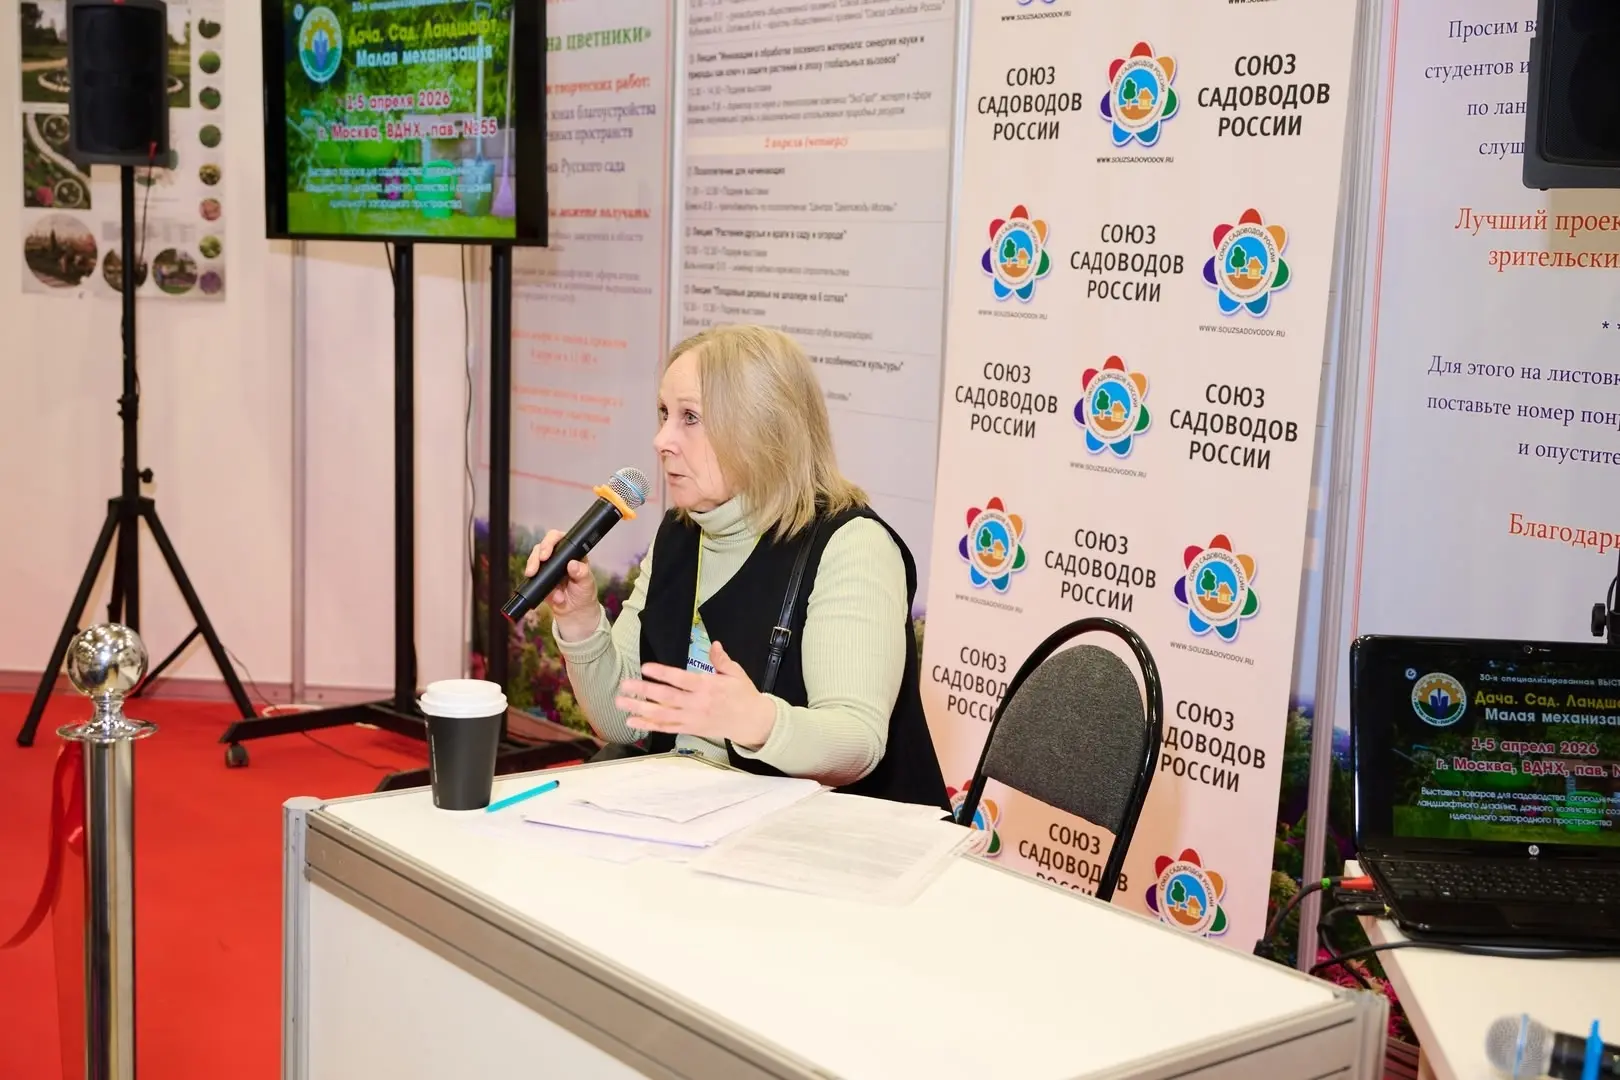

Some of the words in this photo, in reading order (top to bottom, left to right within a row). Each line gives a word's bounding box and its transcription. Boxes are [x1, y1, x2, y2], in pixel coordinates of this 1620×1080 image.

[1449, 20, 1518, 43] Просим
[356, 49, 398, 67] Малая
[402, 45, 492, 64] механизация
[1235, 54, 1296, 76] СОЮЗ
[1007, 66, 1055, 86] СОЮЗ
[1425, 62, 1513, 83] студентов
[370, 96, 414, 112] апреля
[418, 91, 450, 108] 2026
[978, 93, 1082, 117] САДОВОДОВ
[1198, 83, 1330, 111] САДОВОДОВ
[1467, 103, 1488, 116] по
[993, 121, 1060, 140] РОССИИ
[1218, 115, 1302, 137] РОССИИ
[1455, 208, 1548, 236] Лучший
[1101, 224, 1156, 244] СОЮЗ
[1070, 251, 1184, 276] САДОВОДОВ
[1489, 249, 1620, 272] зрительски
[1088, 280, 1161, 302] РОССИИ
[1199, 325, 1285, 337] WWW.SOUZSADOVODOV.RU
[983, 362, 1031, 384] СОЮЗ
[1427, 355, 1462, 376] Для
[1467, 363, 1514, 378] этого
[1521, 366, 1540, 380] на
[955, 385, 1058, 414] САДОВОДОВ
[1205, 383, 1265, 408] СОЮЗ
[1427, 397, 1511, 416] поставьте
[1517, 404, 1574, 427] номер
[970, 414, 1036, 438] РОССИИ
[1170, 409, 1298, 442] САДОВОДОВ
[1190, 440, 1270, 470] РОССИИ
[1518, 443, 1529, 456] и
[1535, 445, 1620, 465] опустите
[1075, 529, 1128, 555] СОЮЗ
[1045, 550, 1156, 588] САДОВОДОВ
[1061, 581, 1133, 613] РОССИИ
[960, 646, 1007, 673] СОЮЗ
[1170, 641, 1254, 665] WWW.SOUZSADOVODOV.RU
[932, 664, 1009, 702] САДОВОД
[1501, 676, 1595, 686] специализированная
[947, 695, 998, 722] РОССИ
[1475, 691, 1518, 705] Дача.
[1525, 692, 1560, 708] Сад.
[1176, 700, 1234, 731] СОЮЗ
[1485, 708, 1535, 722] Малая
[1161, 727, 1266, 769] ДОВОДОВ
[1472, 738, 1495, 751] 1-5
[1501, 741, 1554, 755] апреля
[1560, 741, 1598, 755] 2026
[1161, 753, 1240, 792] РОССИИ
[1436, 758, 1448, 769] г.
[1454, 757, 1516, 774] Москва,
[1523, 760, 1569, 778] ВДНХ,
[1575, 763, 1607, 778] пав.
[1421, 786, 1460, 797] Выставка
[1462, 790, 1495, 800] товаров
[1497, 792, 1510, 800] для
[1417, 798, 1478, 810] ландшафтного
[1480, 801, 1517, 812] дизайна,
[1519, 804, 1552, 814] дачного
[1450, 811, 1497, 822] идеального
[1499, 814, 1551, 826] загородного
[1553, 817, 1612, 828] пространства
[1049, 823, 1100, 855] СОЮЗ
[1019, 840, 1128, 892] САДОВОДВ
